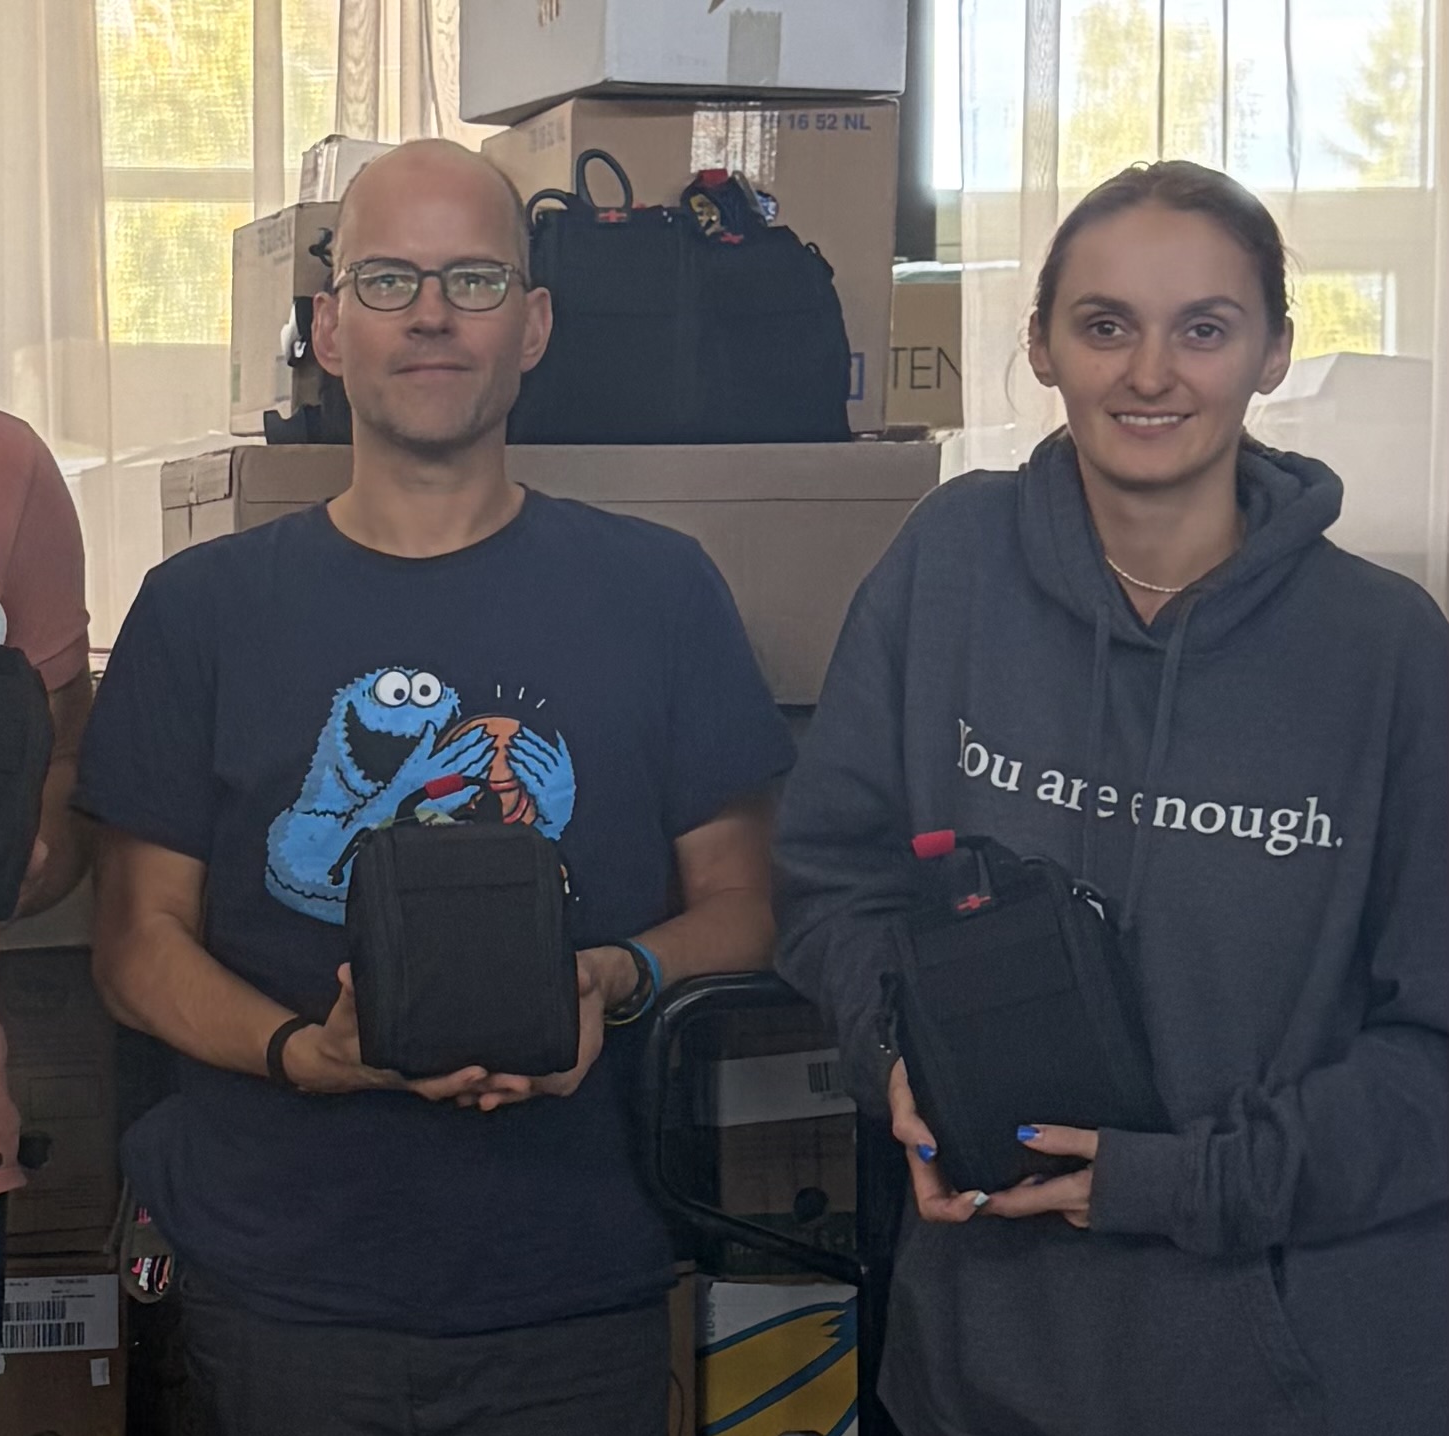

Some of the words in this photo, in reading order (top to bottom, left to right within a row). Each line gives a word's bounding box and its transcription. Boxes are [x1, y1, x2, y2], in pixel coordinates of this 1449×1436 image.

[788, 113, 809, 131] 16
[816, 113, 838, 131] 52
[844, 113, 872, 131] NL
[957, 718, 1021, 792] You
[1037, 768, 1119, 818] are
